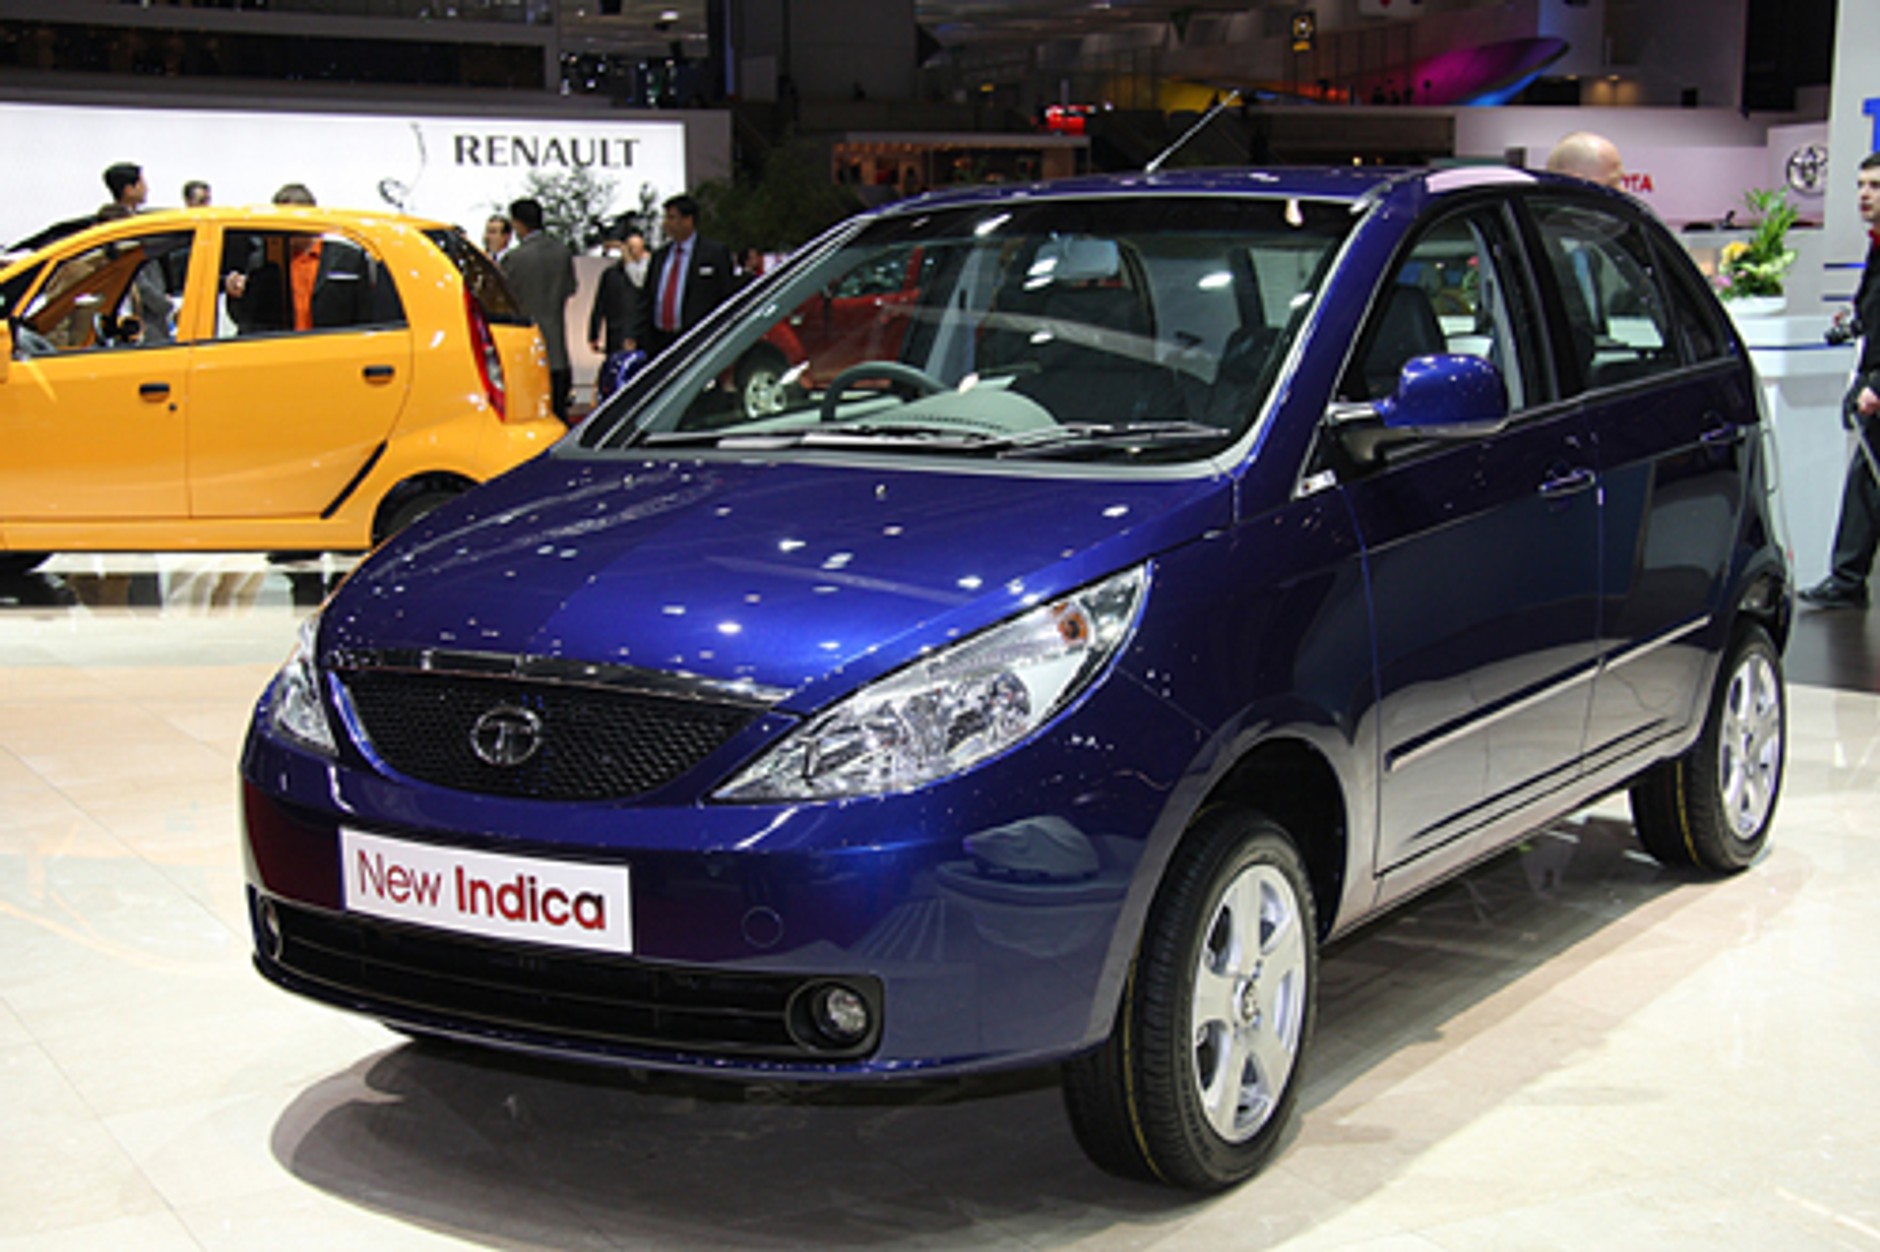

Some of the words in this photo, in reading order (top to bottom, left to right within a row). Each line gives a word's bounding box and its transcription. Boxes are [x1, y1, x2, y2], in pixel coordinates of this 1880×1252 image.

[454, 134, 640, 168] RENAULT
[357, 849, 442, 906] New
[455, 865, 606, 930] Indica
